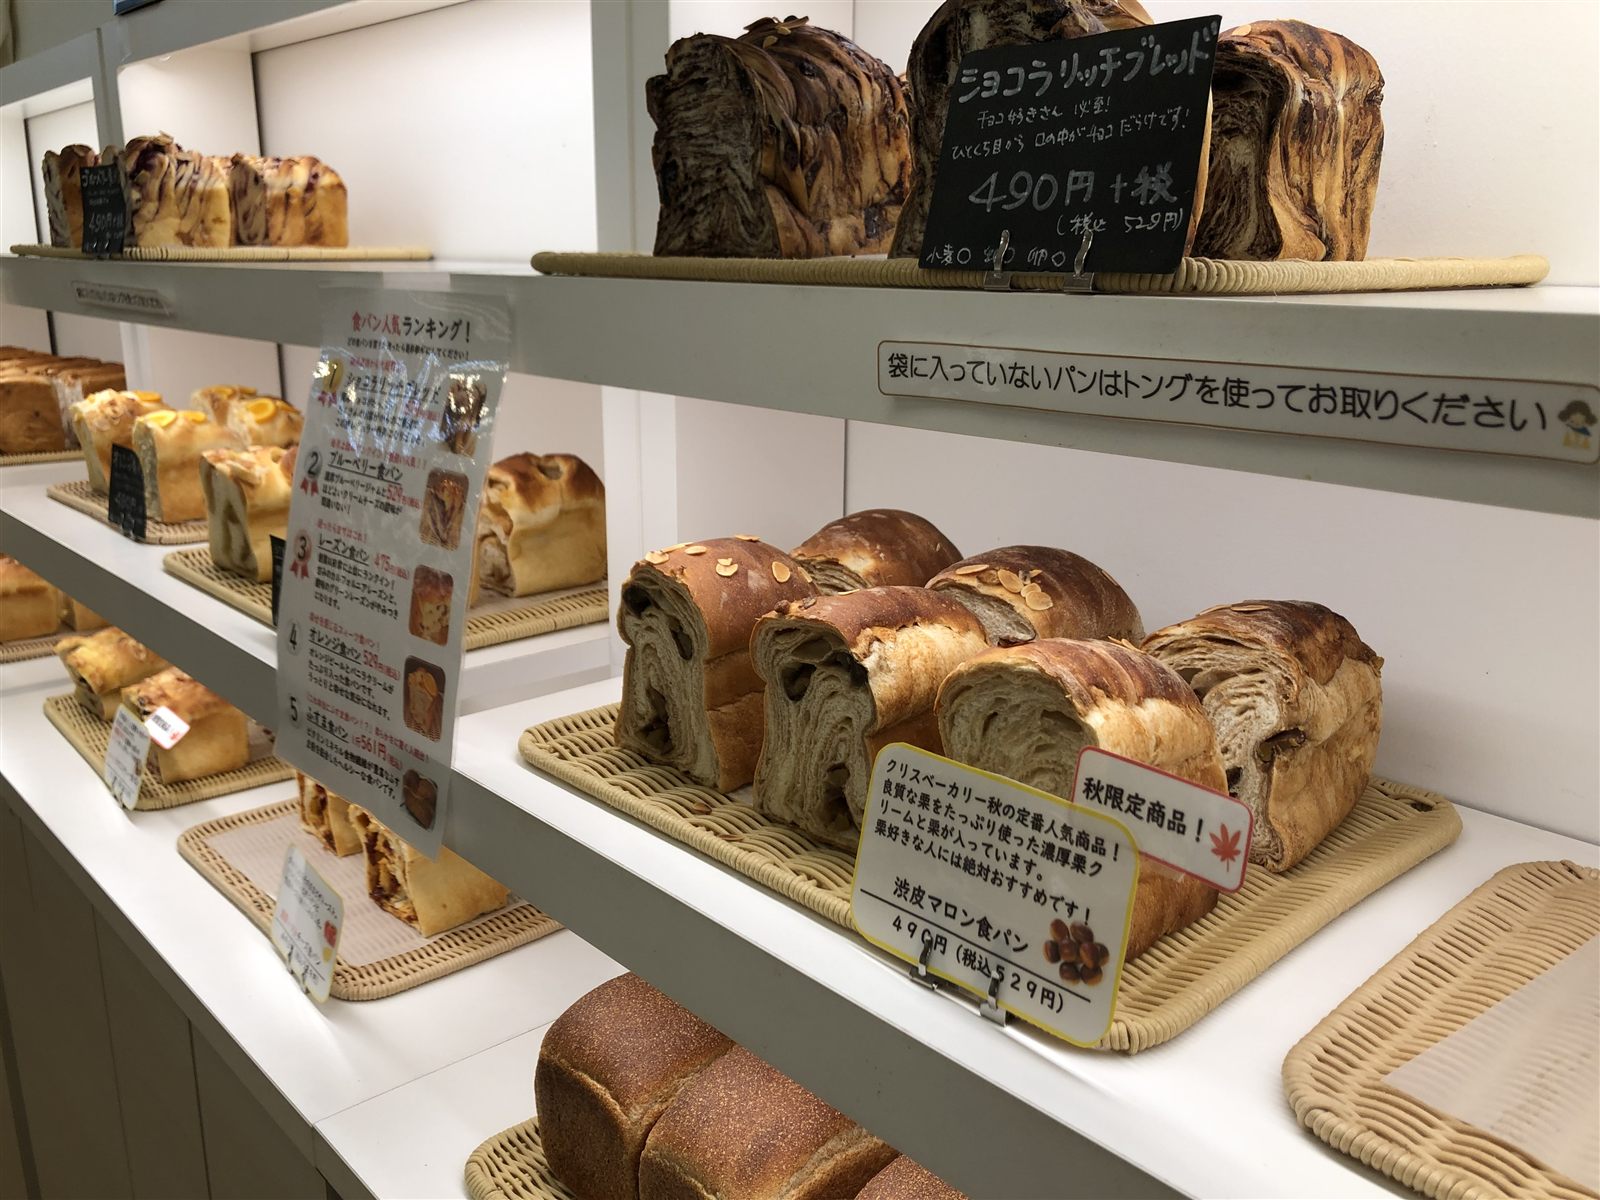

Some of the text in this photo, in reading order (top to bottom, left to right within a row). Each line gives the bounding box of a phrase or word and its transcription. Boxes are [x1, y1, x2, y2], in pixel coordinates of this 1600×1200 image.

[888, 352, 1547, 431] 袋に入っていないパンはトングを使ってお取りください
[308, 451, 319, 476] 2
[330, 451, 403, 481] ブルーベリー食パン
[297, 536, 307, 560] 3
[319, 533, 370, 561] レーズン食パン
[289, 623, 298, 650] 4
[309, 628, 361, 660] オレンジ食パン
[290, 696, 298, 722] 5
[882, 778, 1103, 878] 良質な栗をたっぷり使った濃厚栗ク
[886, 758, 1120, 862] クリスベーカリー秋の定番人気商品！
[1082, 776, 1204, 843] 秋限定商品！
[880, 799, 1043, 882] リームと栗が入っています。
[874, 818, 1090, 926] 栗好きな人には絶対おすすめです！
[892, 876, 1029, 953] 渋皮マロン食パン
